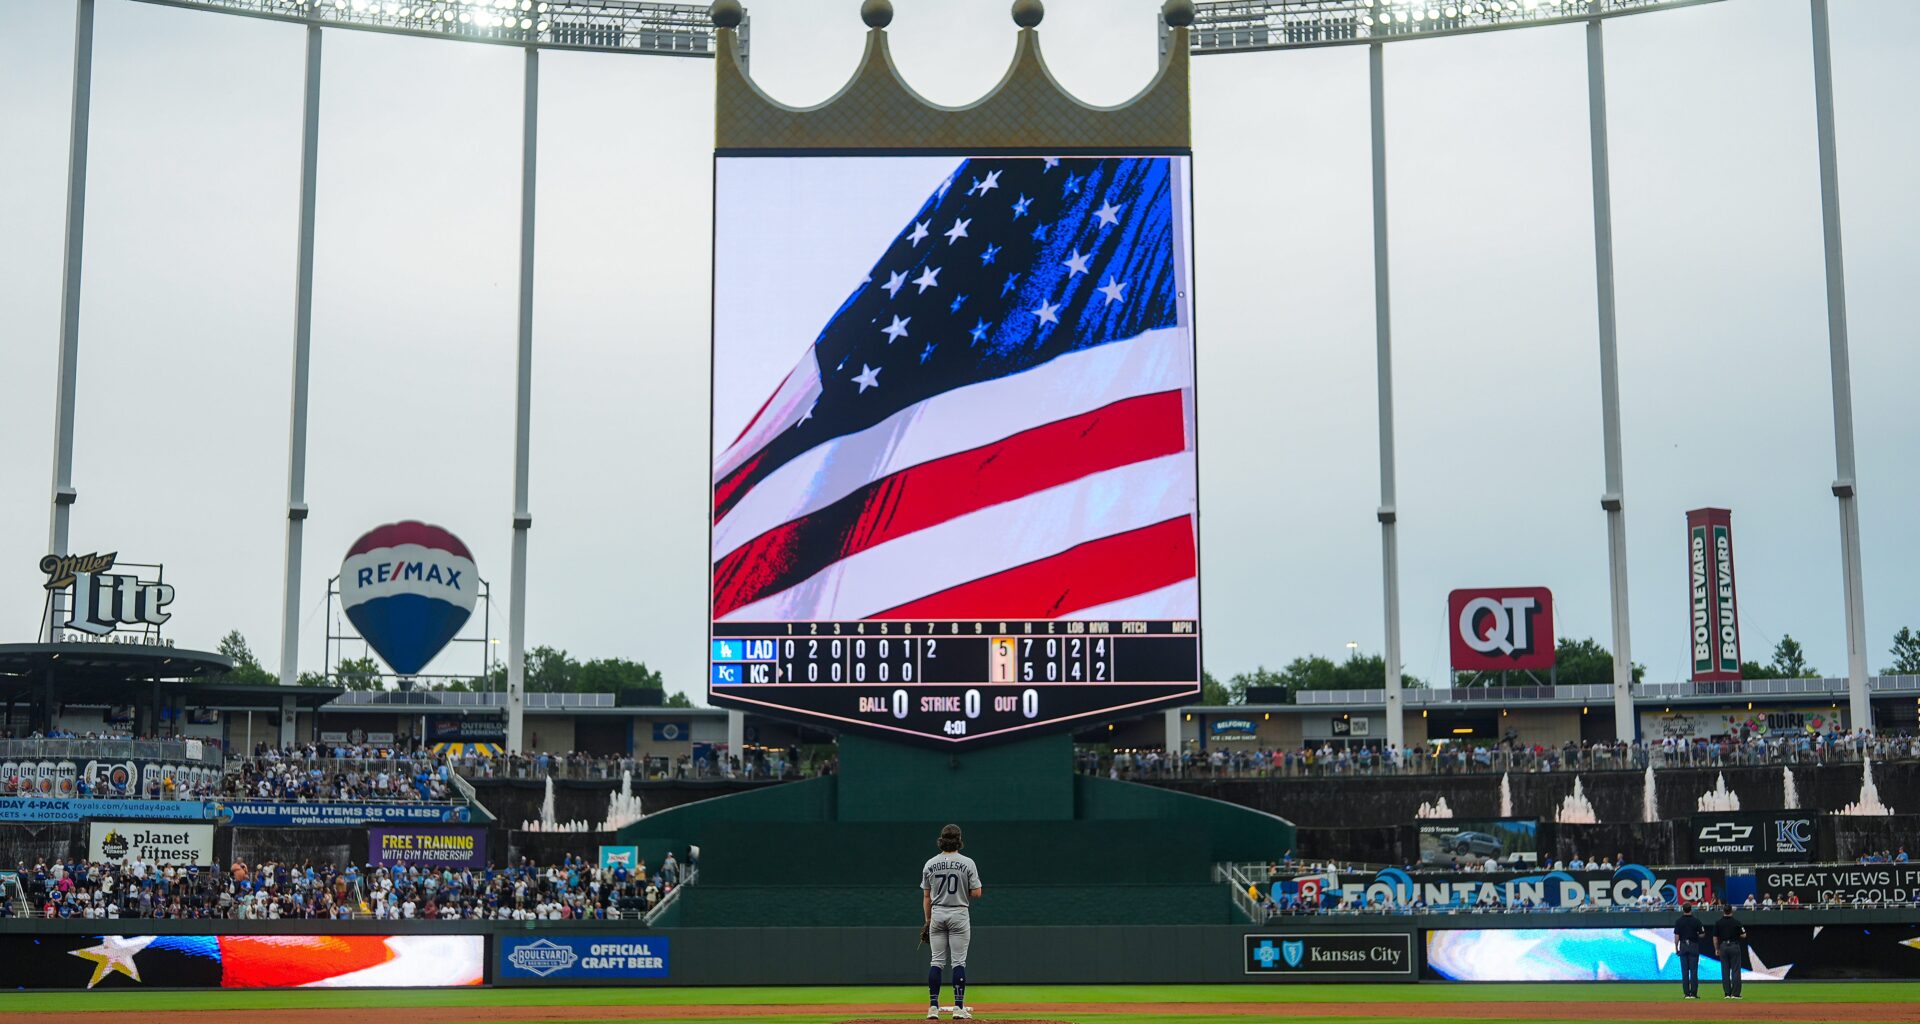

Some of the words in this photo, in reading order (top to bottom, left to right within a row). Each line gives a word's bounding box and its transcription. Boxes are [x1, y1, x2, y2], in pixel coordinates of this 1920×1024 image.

[42, 554, 114, 588] Miller
[358, 561, 462, 591] RE/MAX
[65, 571, 175, 636] Lite
[1692, 536, 1710, 661] BOULEVARD
[1717, 535, 1735, 660] BOULEVARD
[787, 624, 792, 634] 1
[810, 624, 817, 634] 2
[834, 624, 840, 634] 3
[858, 624, 864, 634] 4
[881, 624, 888, 634] 5
[904, 623, 911, 634] 6
[928, 623, 934, 633] 7
[952, 623, 958, 633] 8
[975, 623, 982, 633] 9
[1000, 622, 1006, 633] R
[1025, 622, 1032, 633] H
[1048, 622, 1054, 633] E
[1068, 622, 1084, 633] LOB
[1090, 622, 1109, 633] MVR
[1122, 622, 1147, 633] PITCH
[1172, 622, 1192, 633] MPH
[1459, 597, 1535, 656] QT
[147, 637, 175, 647] BAR
[746, 640, 773, 660] LAD
[785, 640, 794, 659] 0
[809, 640, 818, 659] 2
[832, 640, 841, 659] 0
[856, 640, 865, 659] 0
[880, 640, 889, 659] 0
[904, 639, 910, 658] 1
[927, 639, 936, 658] 2
[1000, 640, 1007, 656] 5
[1024, 639, 1033, 658] 7
[1046, 639, 1056, 658] 0
[1071, 639, 1080, 658] 2
[1096, 639, 1105, 658] 4
[750, 665, 768, 683] KC
[786, 663, 792, 682] 1
[808, 663, 818, 682] 0
[831, 663, 841, 682] 0
[856, 663, 865, 682] 0
[879, 663, 889, 682] 0
[902, 663, 912, 682] 0
[1000, 663, 1006, 680] 1
[1024, 662, 1033, 681] 5
[1046, 662, 1056, 681] 0
[1071, 662, 1081, 681] 4
[1096, 662, 1105, 681] 2
[859, 697, 888, 712] BALL
[893, 689, 908, 719] 0
[920, 697, 960, 712] STRIKE
[965, 689, 981, 718] 0
[994, 697, 1018, 712] OUT
[1022, 689, 1038, 718] 0
[944, 721, 966, 735] 4:01
[1767, 713, 1804, 729] QUIRK
[3, 767, 18, 778] Lite
[21, 767, 36, 778] Lite
[39, 767, 54, 778] Lite
[59, 767, 75, 778] Lite
[28, 801, 69, 810] 4-PACK
[73, 801, 180, 811] royals.com/sunday4pack
[233, 806, 276, 815] VALUE
[280, 806, 319, 816] MENU
[323, 807, 363, 816] ITEMS
[366, 807, 382, 817] $5
[385, 808, 405, 817] OR
[408, 808, 440, 818] LESS
[133, 830, 189, 847] planet
[382, 835, 412, 849] FREE
[416, 835, 474, 849] TRAINING
[1775, 819, 1811, 852] KC
[141, 846, 199, 860] fitness
[382, 849, 402, 860] WITH
[405, 849, 421, 860] GYM
[423, 850, 474, 860] MEMBERSHIP
[1699, 845, 1754, 853] CHEVROLET
[935, 874, 958, 895] 70
[1768, 873, 1827, 887] GREAT
[1832, 872, 1890, 886] VIEWS
[1906, 871, 1920, 885] F
[1342, 881, 1544, 907] FOUNTAIN
[1560, 879, 1668, 908] DECK
[1680, 881, 1706, 901] QT
[519, 949, 567, 964] BOULEVARD
[590, 944, 651, 956] OFFICIAL
[1311, 947, 1366, 962] Kansas
[1370, 947, 1401, 964] City
[581, 958, 626, 969] CRAFT
[628, 958, 663, 969] BEER
